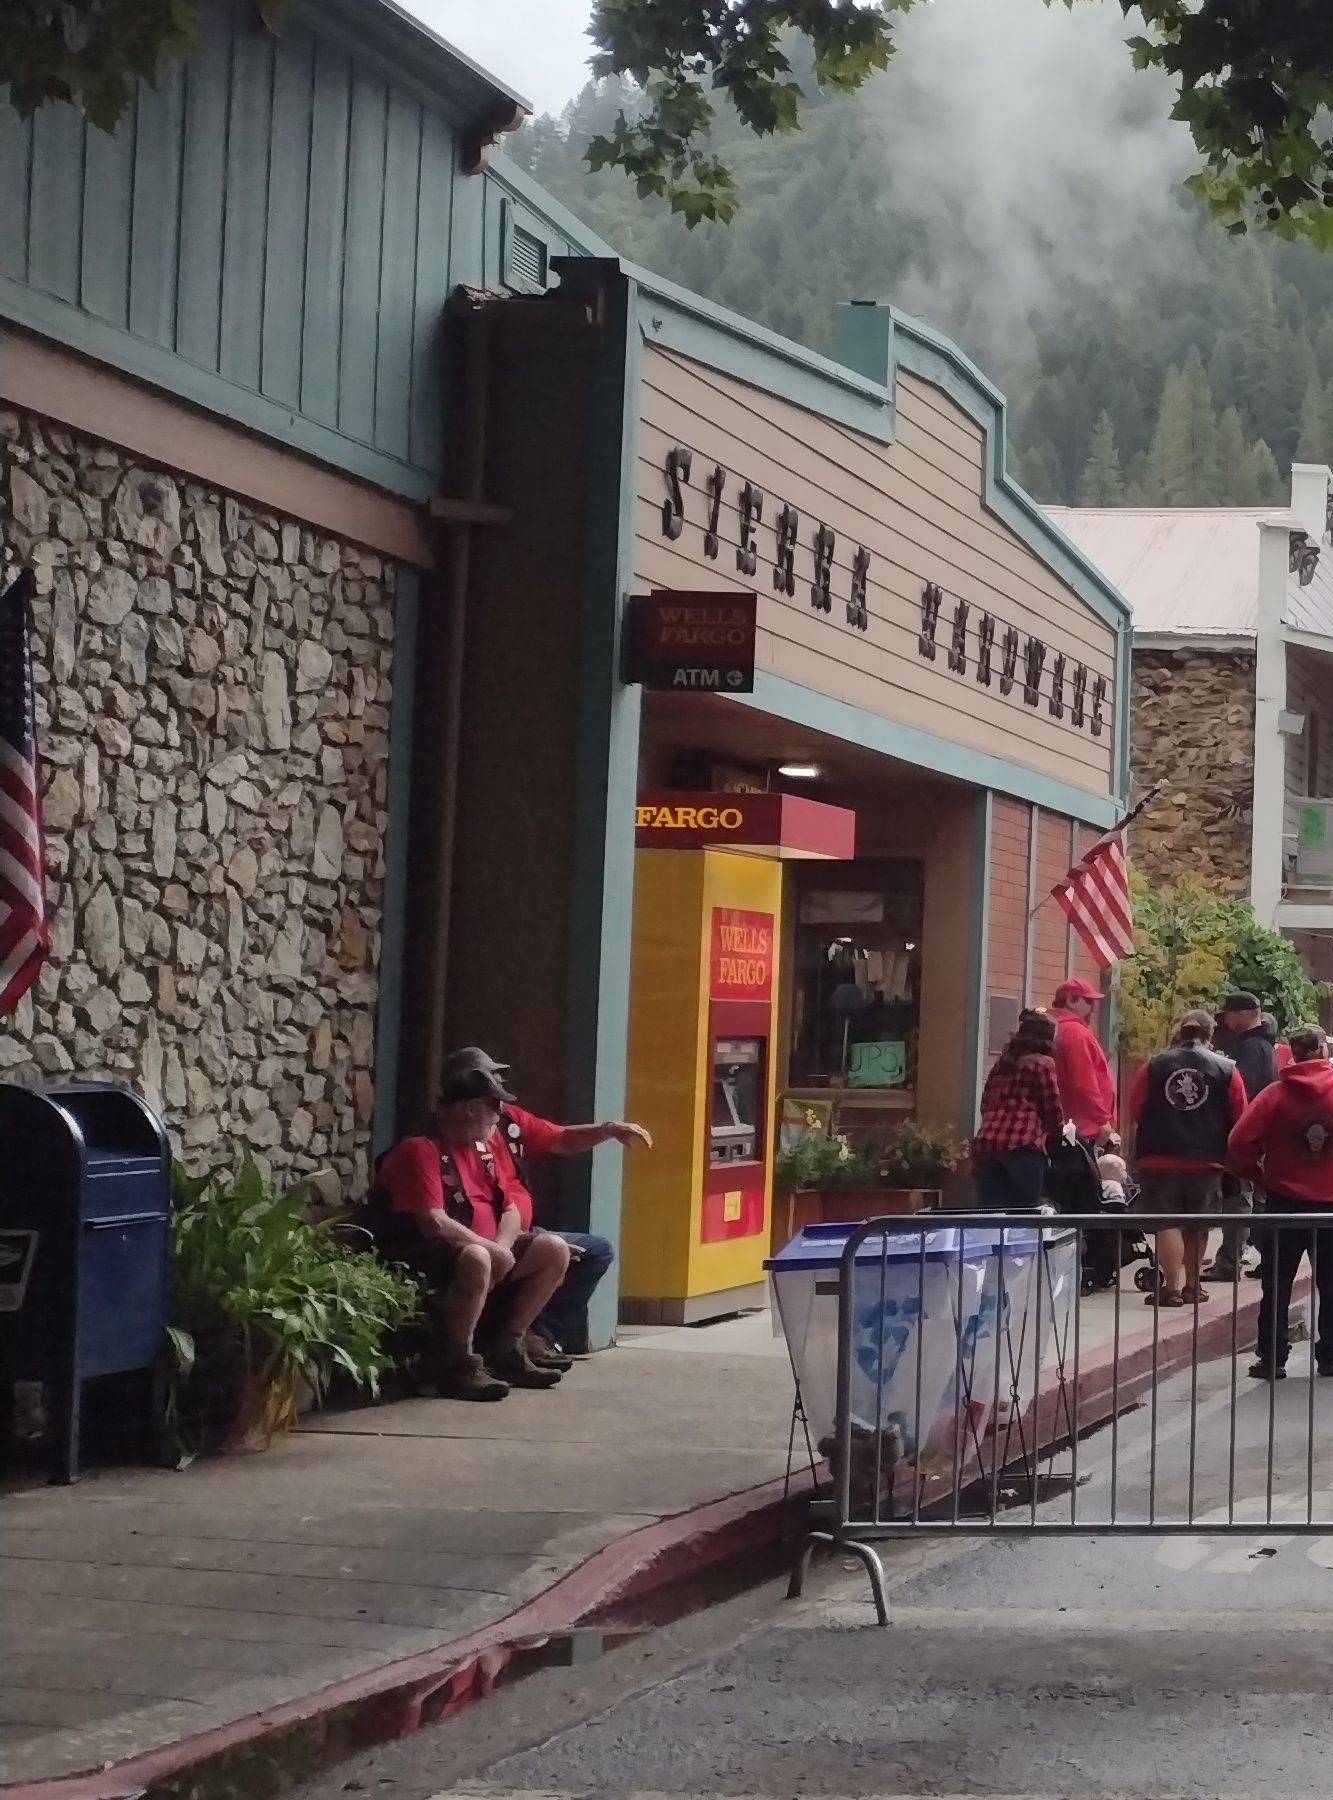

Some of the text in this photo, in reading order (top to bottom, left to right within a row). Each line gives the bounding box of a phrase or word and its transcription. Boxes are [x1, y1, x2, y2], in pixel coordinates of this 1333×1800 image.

[662, 446, 1107, 737] SIERRA HARDWARE
[658, 607, 747, 625] WELLS
[658, 625, 745, 645] FARGO
[673, 668, 719, 687] ATM
[635, 806, 743, 829] FARGO
[719, 925, 768, 955] WELLS
[718, 957, 767, 986] FARGO
